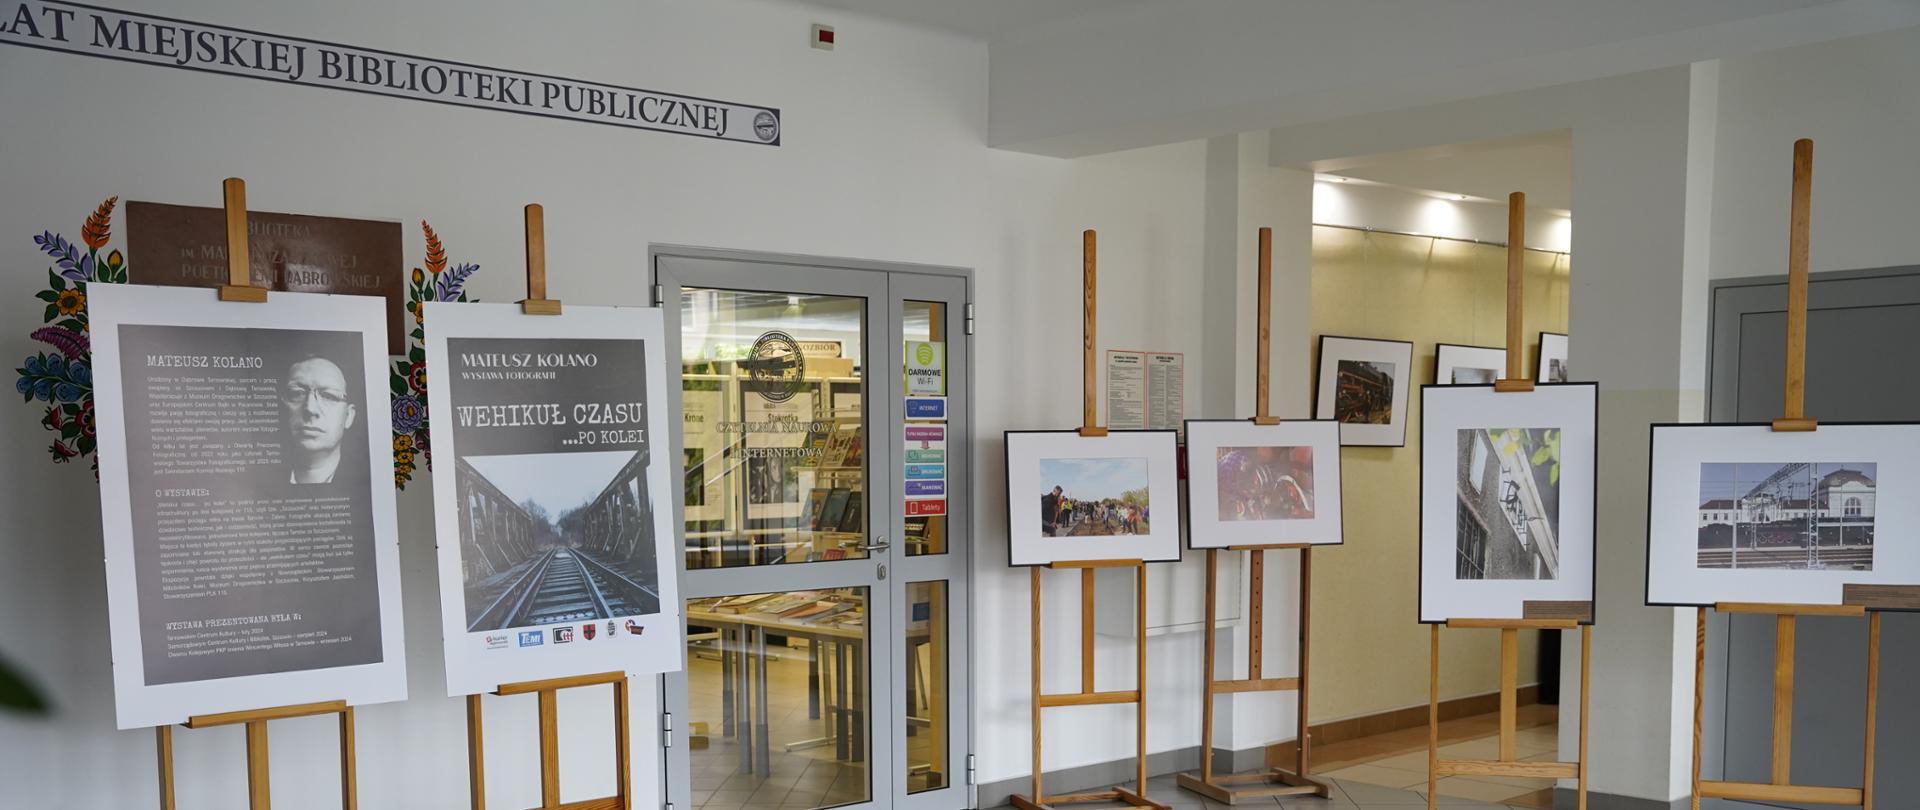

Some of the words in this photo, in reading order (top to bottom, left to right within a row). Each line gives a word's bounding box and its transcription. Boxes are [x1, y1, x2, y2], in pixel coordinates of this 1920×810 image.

[89, 14, 307, 81] MIEJSKIEJ
[318, 48, 534, 107] BIBLIOTEKI
[540, 82, 730, 137] PUBLICZNEJ
[146, 354, 209, 368] MATEUSZ
[212, 356, 263, 369] KOLANO
[461, 353, 532, 367] MATEUSZ
[537, 353, 598, 367] KOLANO
[462, 371, 504, 381] WYSTAWA
[506, 371, 556, 380] FOTOGRAFII
[908, 368, 942, 377] DARMOWE
[456, 404, 567, 427] WEHIKUŁ
[573, 403, 643, 425] CZASU
[562, 432, 596, 445] ...PO
[601, 430, 645, 444] KOLEI
[155, 489, 162, 498] O
[164, 488, 210, 497] WYSTAWIE:
[166, 620, 203, 630] WYSTAWA
[205, 615, 269, 628] PREZENTOWANA
